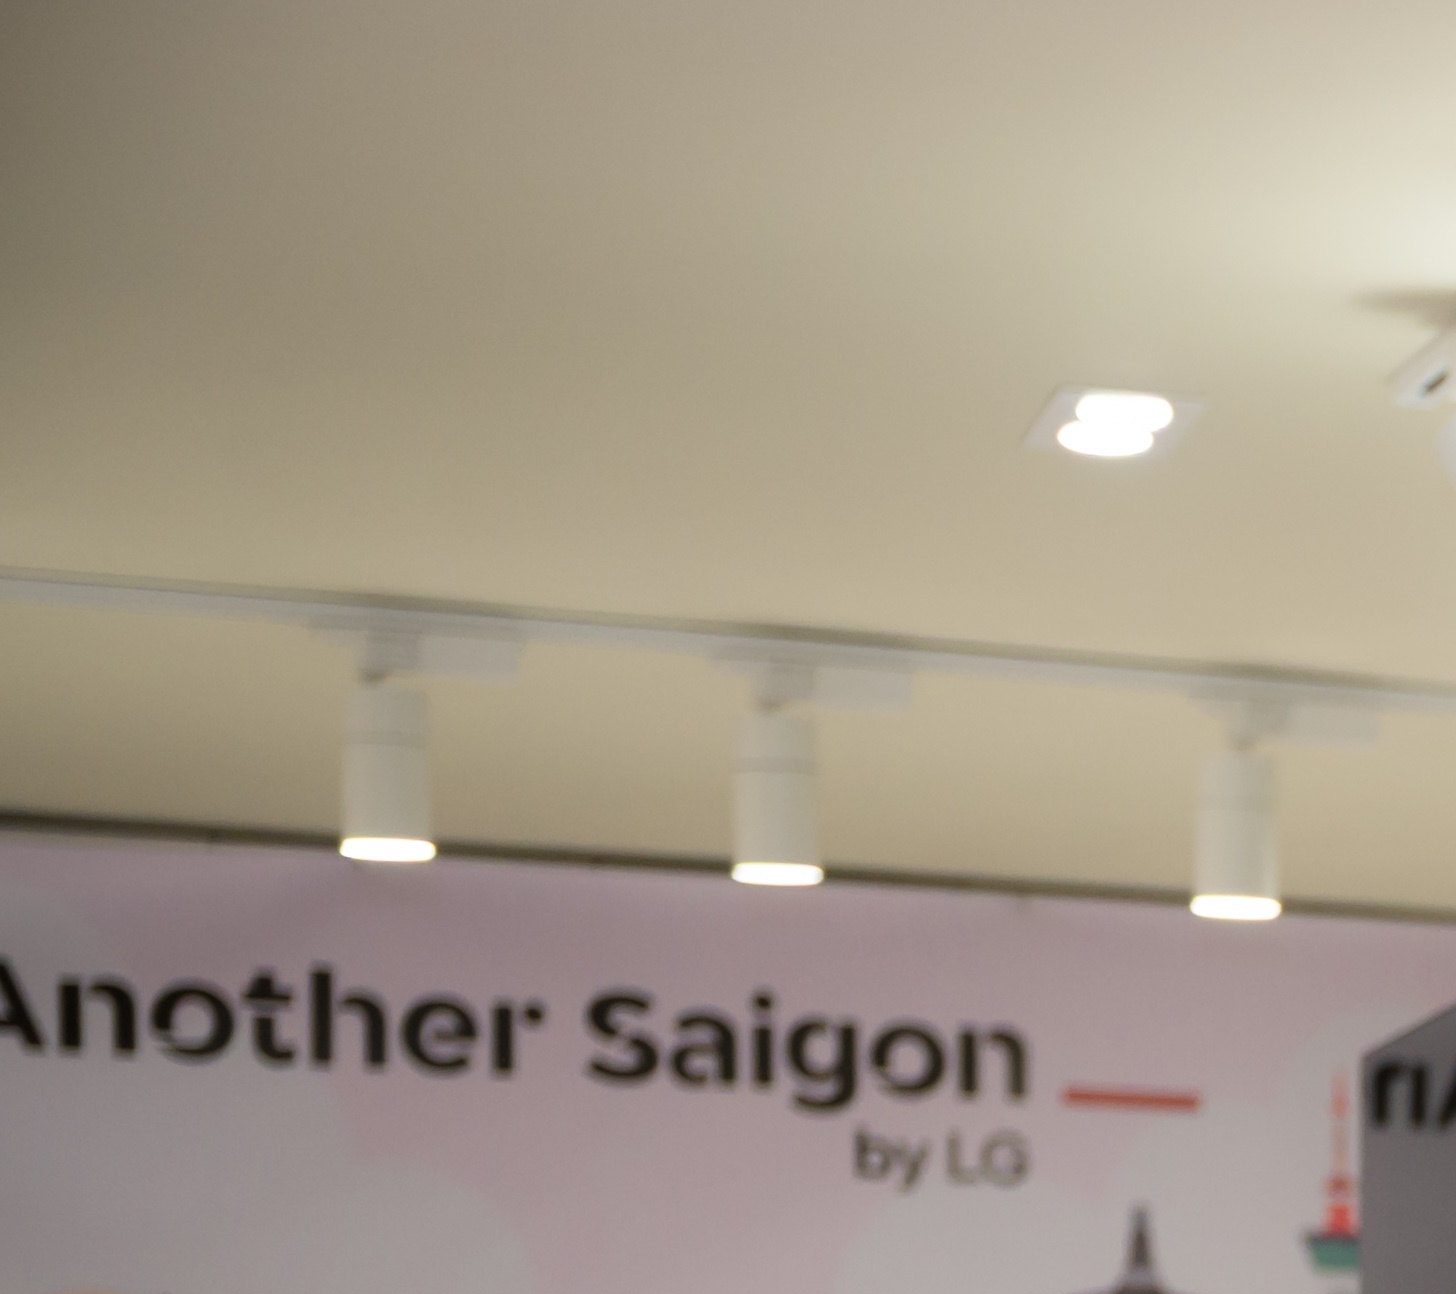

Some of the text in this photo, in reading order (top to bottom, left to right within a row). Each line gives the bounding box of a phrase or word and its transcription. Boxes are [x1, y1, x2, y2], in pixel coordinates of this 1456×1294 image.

[582, 986, 1030, 1114] Saigon
[849, 1123, 1032, 1193] by LG
